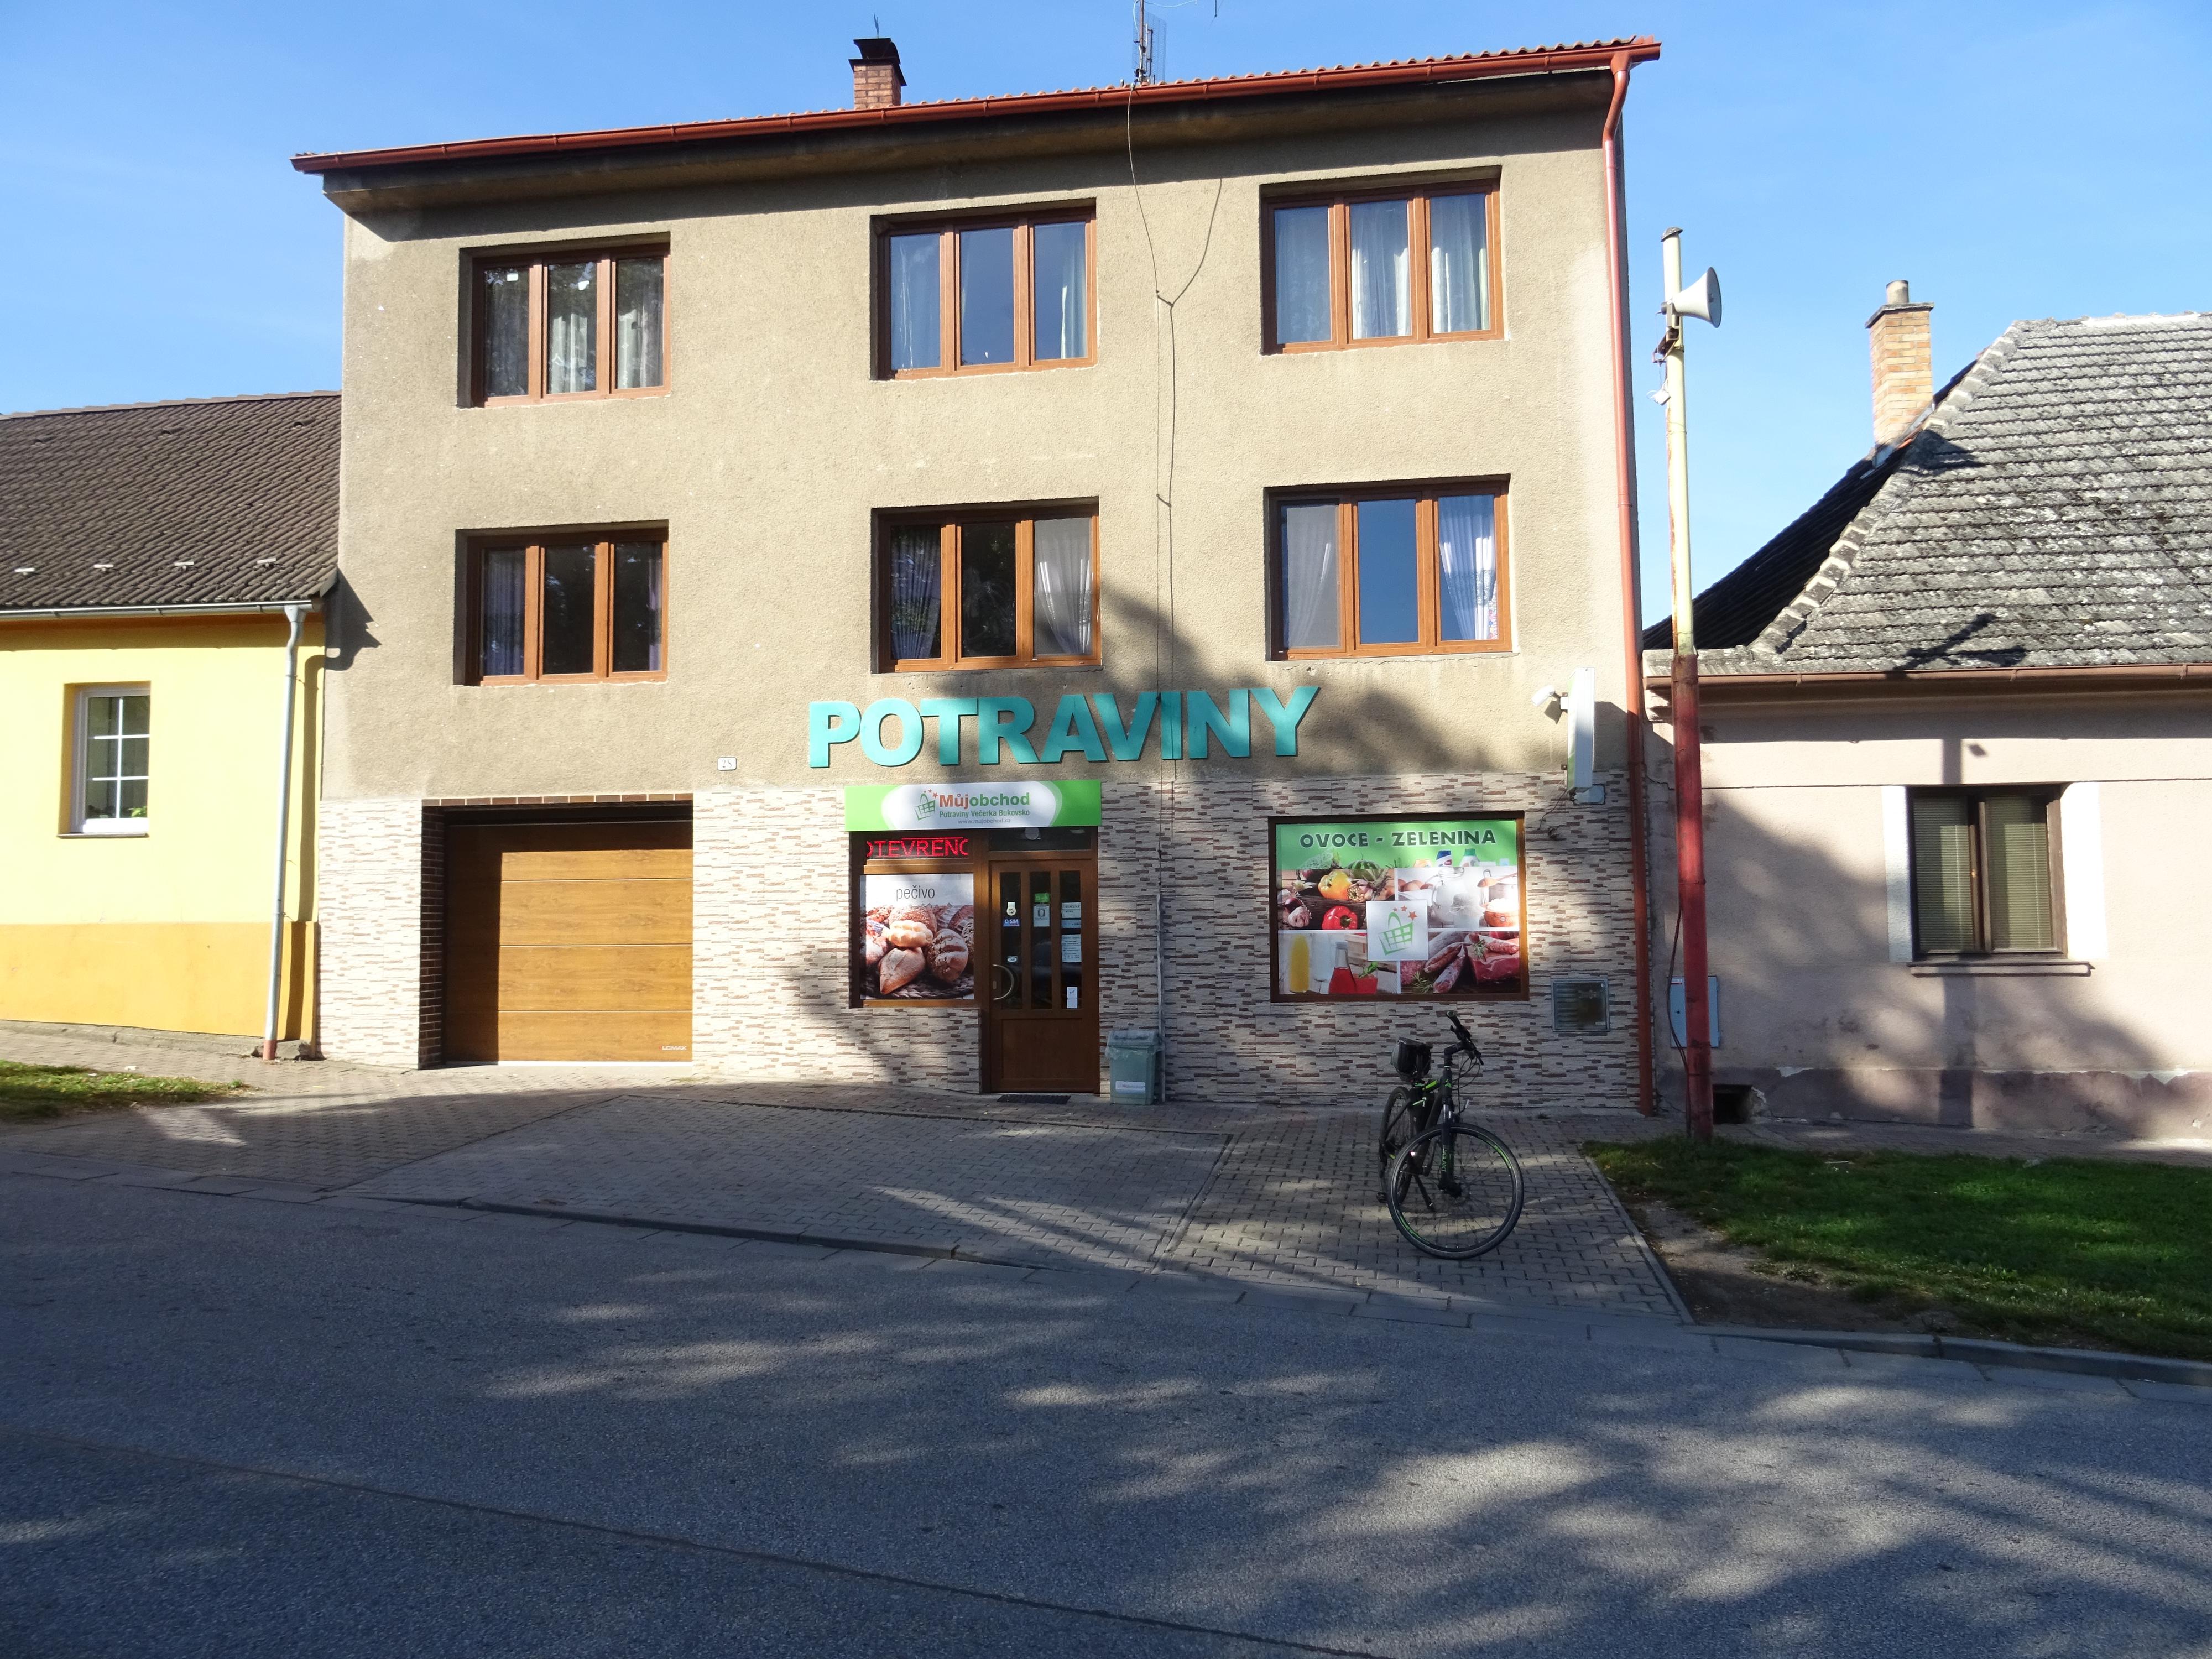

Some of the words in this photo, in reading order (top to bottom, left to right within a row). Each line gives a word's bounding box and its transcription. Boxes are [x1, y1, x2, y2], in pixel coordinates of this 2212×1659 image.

[808, 686, 1319, 768] POTRAVINY
[939, 792, 1030, 810] Můjobchod
[940, 810, 969, 818] Potraviny
[1300, 832, 1368, 848] OVOCE
[1391, 830, 1496, 847] ZELENINA
[896, 885, 935, 901] pečivo
